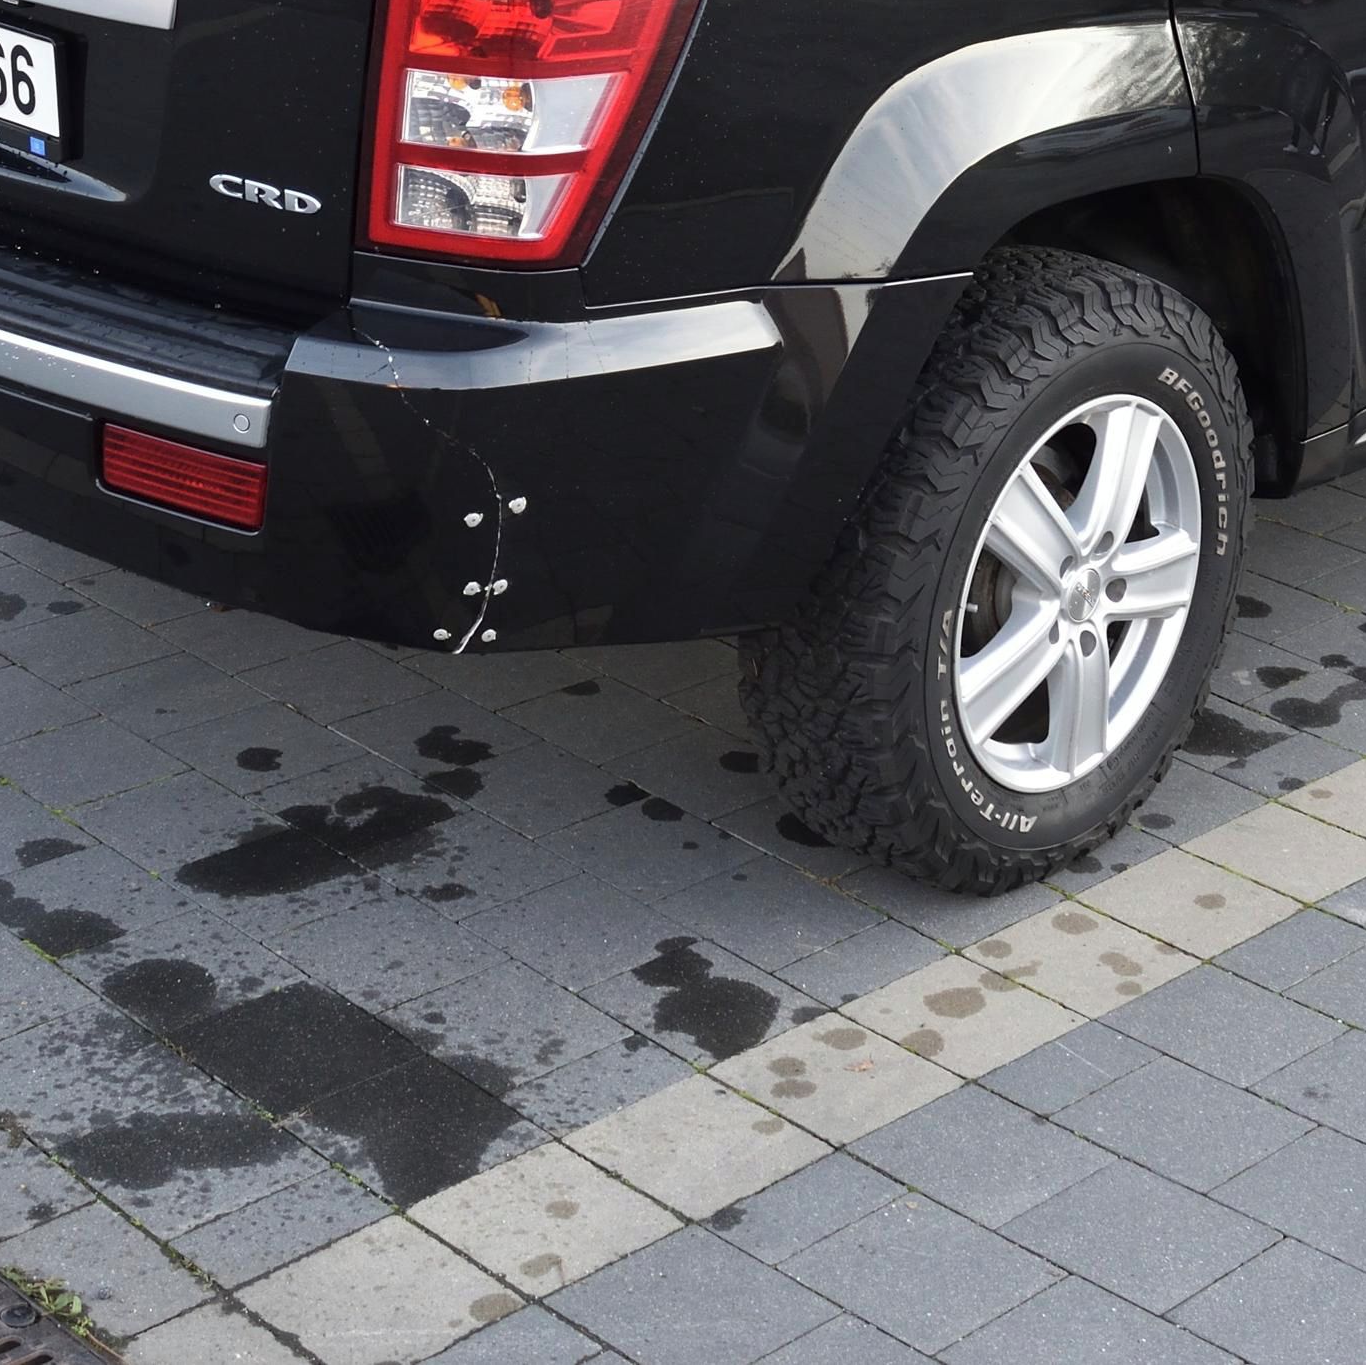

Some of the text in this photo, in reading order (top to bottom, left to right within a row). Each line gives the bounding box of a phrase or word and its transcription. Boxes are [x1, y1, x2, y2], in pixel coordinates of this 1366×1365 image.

[209, 174, 322, 214] CRD
[1157, 367, 1229, 556] BFGoodrich
[940, 699, 1038, 833] All-Terrain
